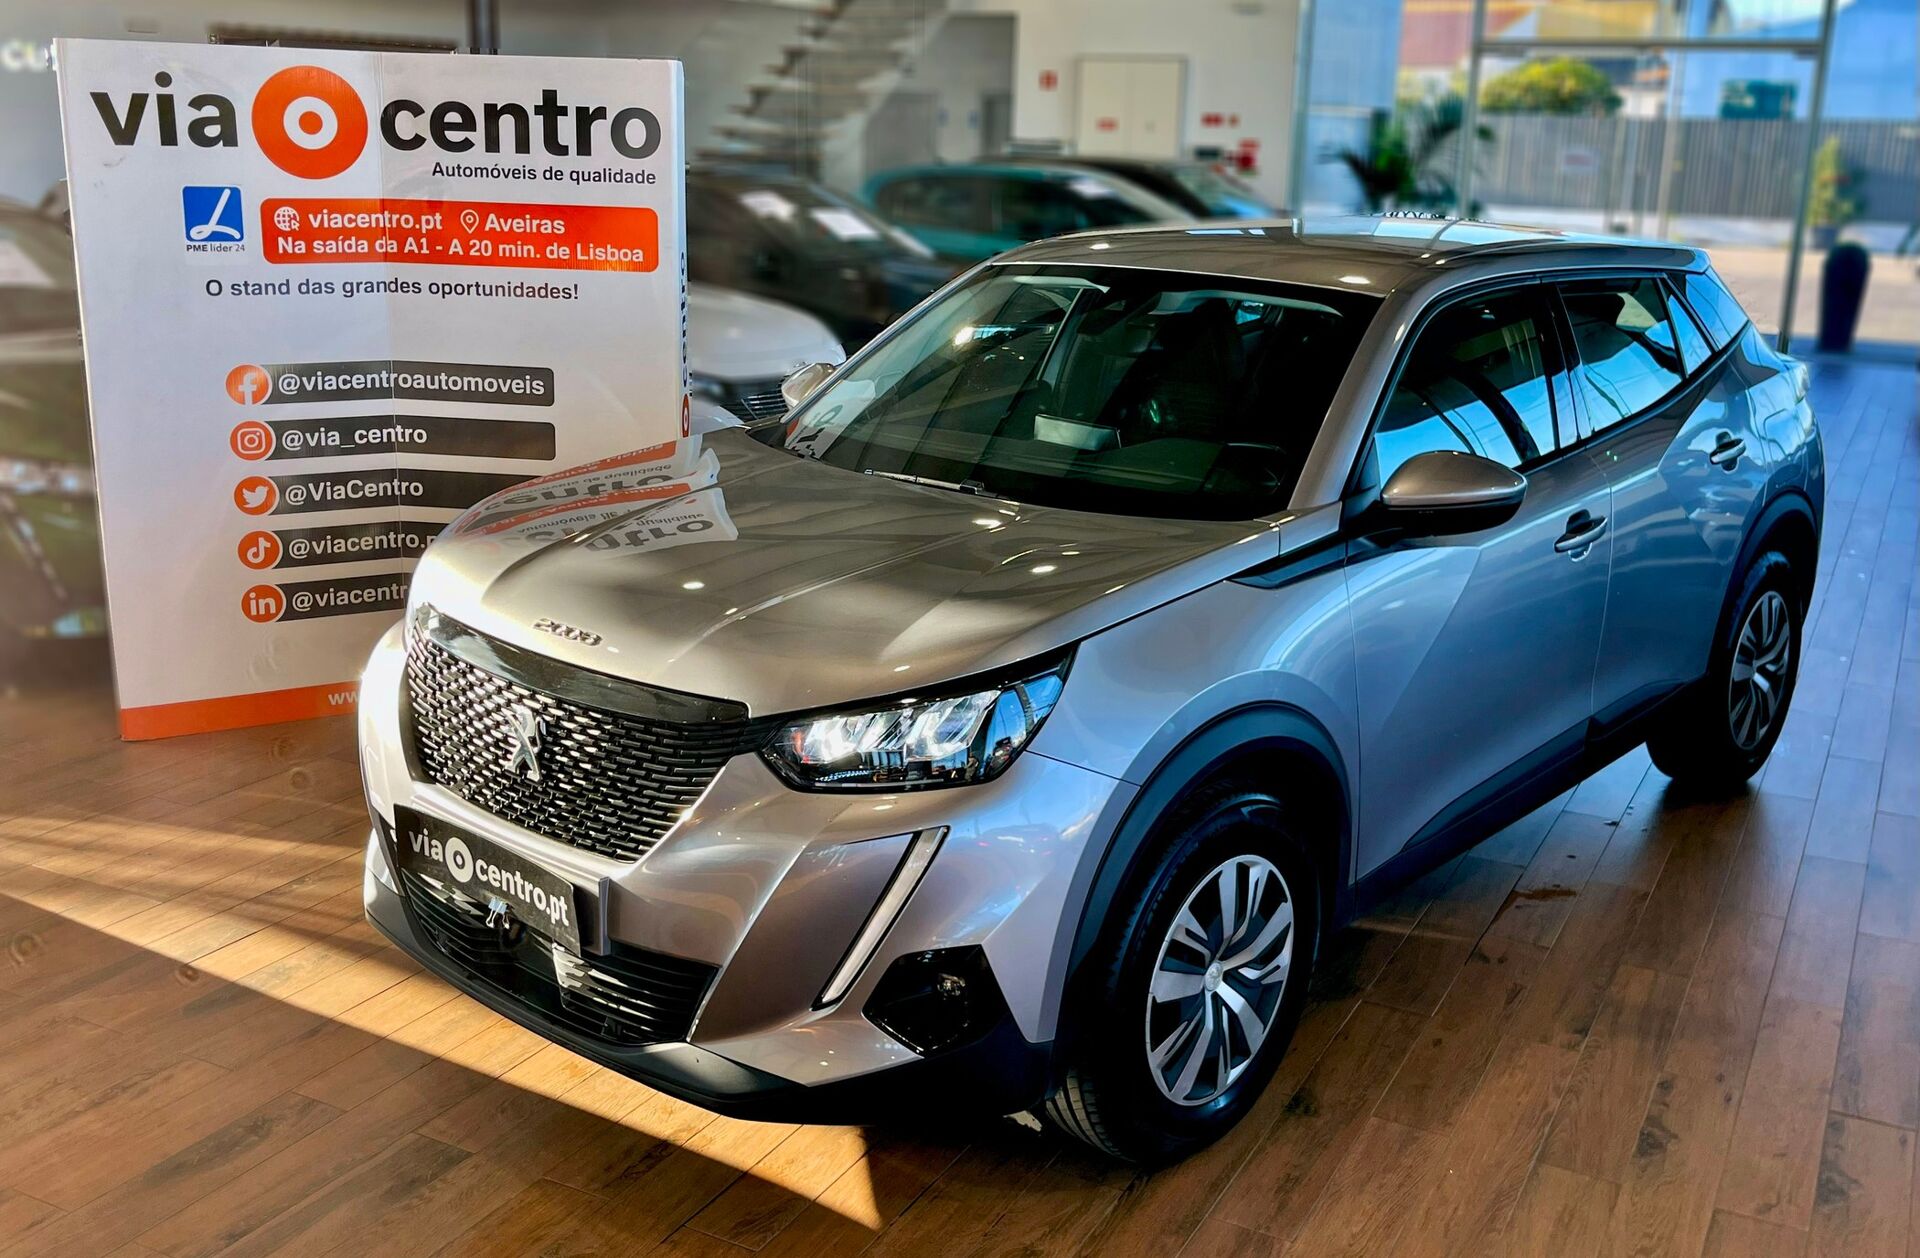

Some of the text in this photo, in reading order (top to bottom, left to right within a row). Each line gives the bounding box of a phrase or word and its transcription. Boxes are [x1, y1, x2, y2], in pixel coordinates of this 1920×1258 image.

[90, 71, 661, 159] via centro
[432, 162, 656, 185] Automóveis de qualidade
[308, 208, 565, 234] viacentro.pt Aveiras
[186, 244, 208, 252] PME
[277, 237, 306, 254] Na
[312, 236, 368, 254] saída
[375, 236, 398, 253] da
[404, 237, 430, 254] A1
[448, 239, 464, 255] A
[469, 240, 492, 257] 20
[498, 241, 541, 258] min.
[546, 242, 570, 260] de
[576, 243, 644, 262] Lisboa
[205, 277, 579, 300] O stand das grandes oportunidades!
[278, 371, 545, 396] @viacentroautomoveis
[281, 424, 428, 451] @via_centro
[285, 478, 424, 506] @ViaCentro
[408, 828, 570, 927] via centro.pt
